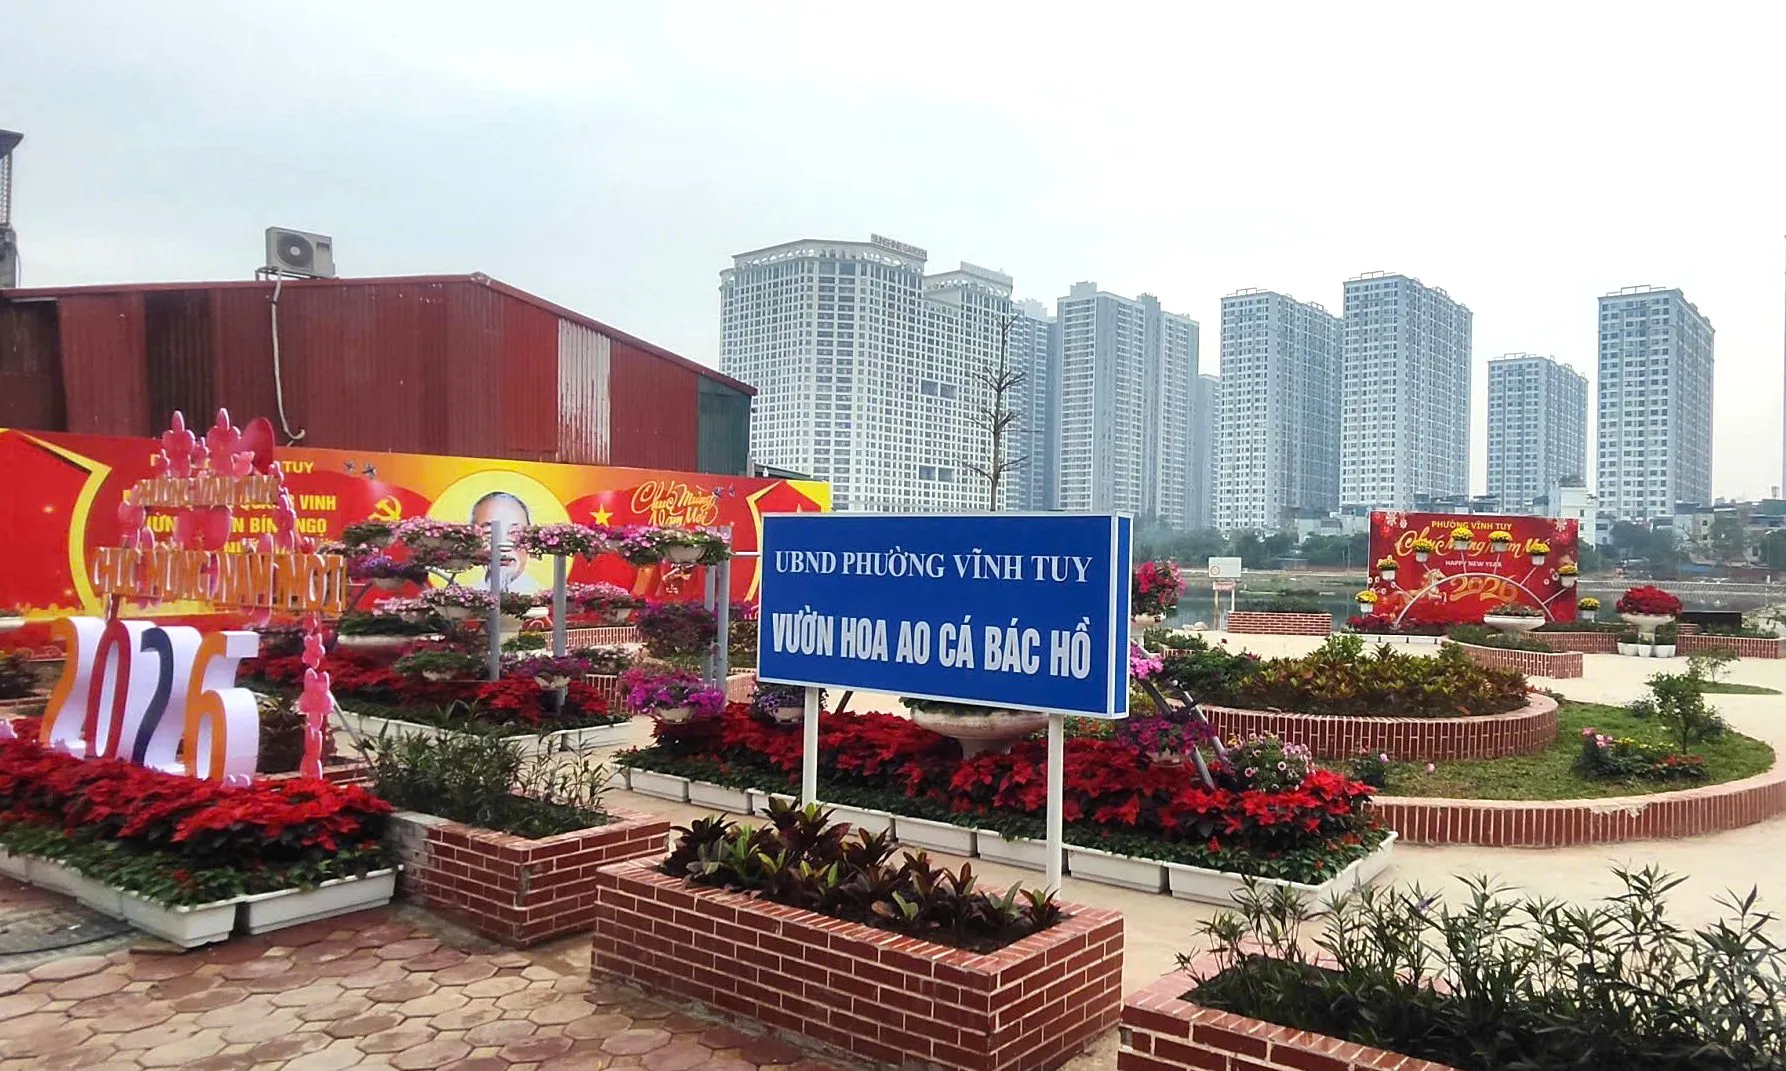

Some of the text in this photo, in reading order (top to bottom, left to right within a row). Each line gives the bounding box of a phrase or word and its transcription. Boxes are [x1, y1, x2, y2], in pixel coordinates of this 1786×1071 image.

[300, 495, 336, 510] VINH
[250, 515, 279, 533] BÍN
[774, 546, 1093, 582] UBND PHƯỜNG VĨNH TUY
[772, 605, 1092, 679] VƯỜN HOA AO CÁ BÁC HỒ
[38, 616, 259, 786] 2026
